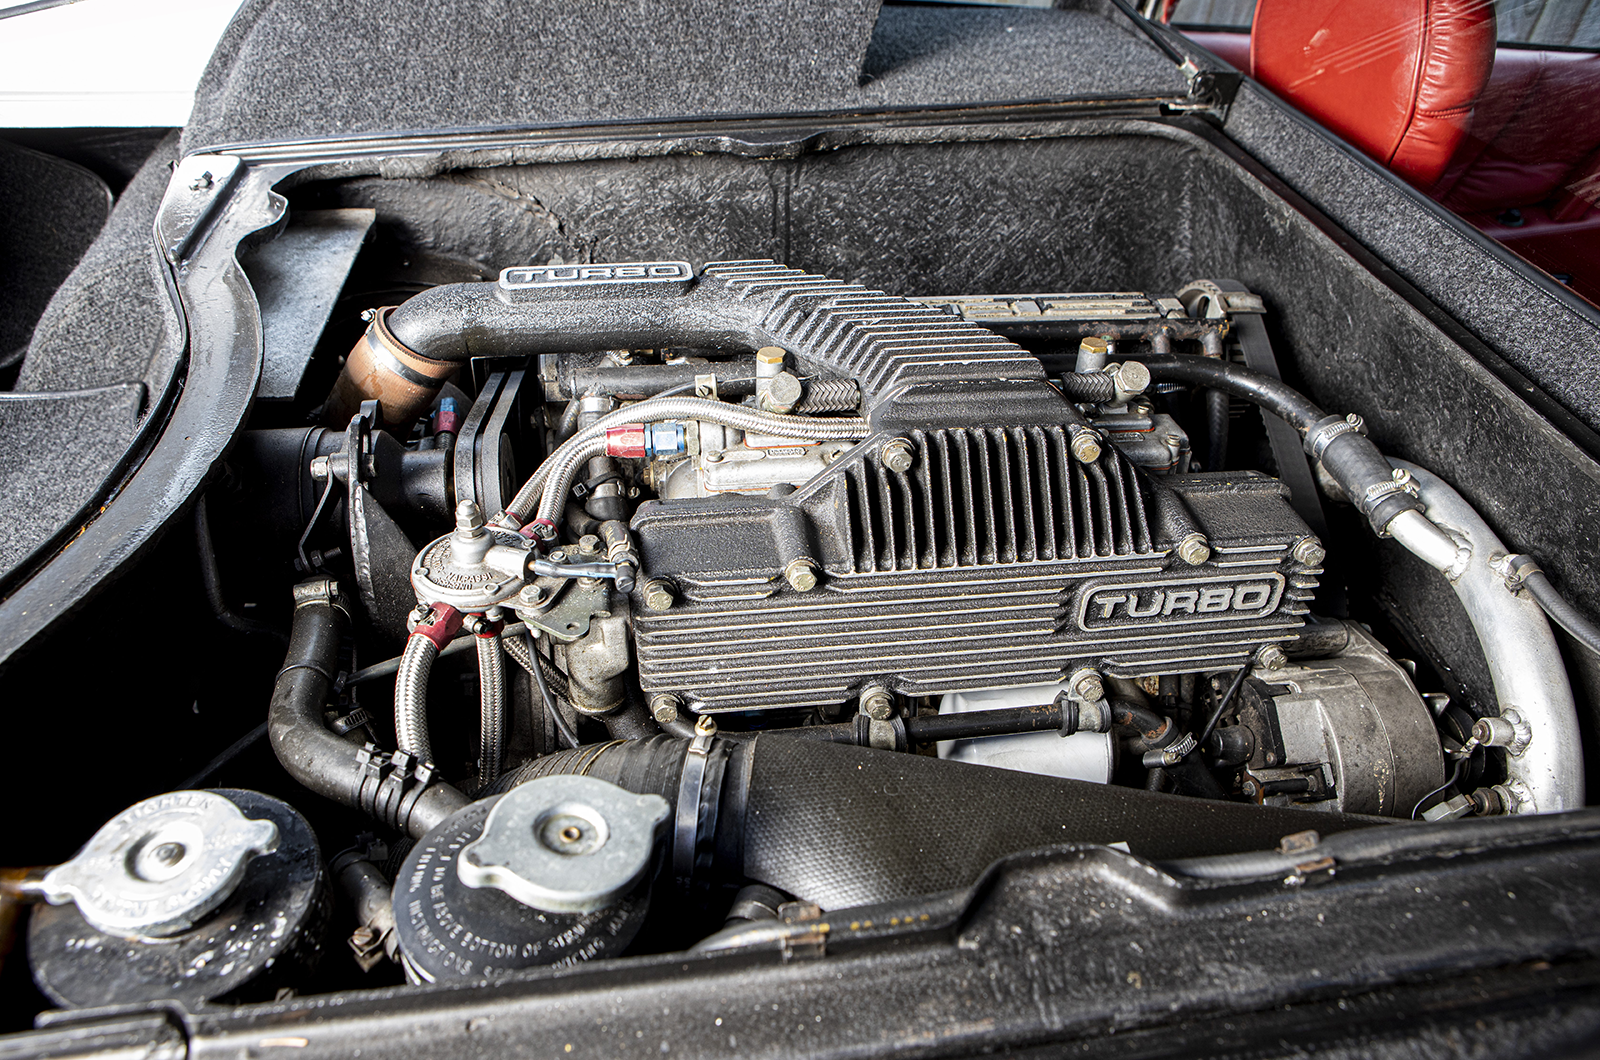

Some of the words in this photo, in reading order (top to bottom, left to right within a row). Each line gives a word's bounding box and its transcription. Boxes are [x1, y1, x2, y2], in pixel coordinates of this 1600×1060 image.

[513, 265, 680, 282] TURBO
[1095, 583, 1271, 618] TURBO
[119, 793, 213, 824] TIGHTEN
[460, 931, 518, 959] BOTTOM
[521, 940, 542, 958] OF
